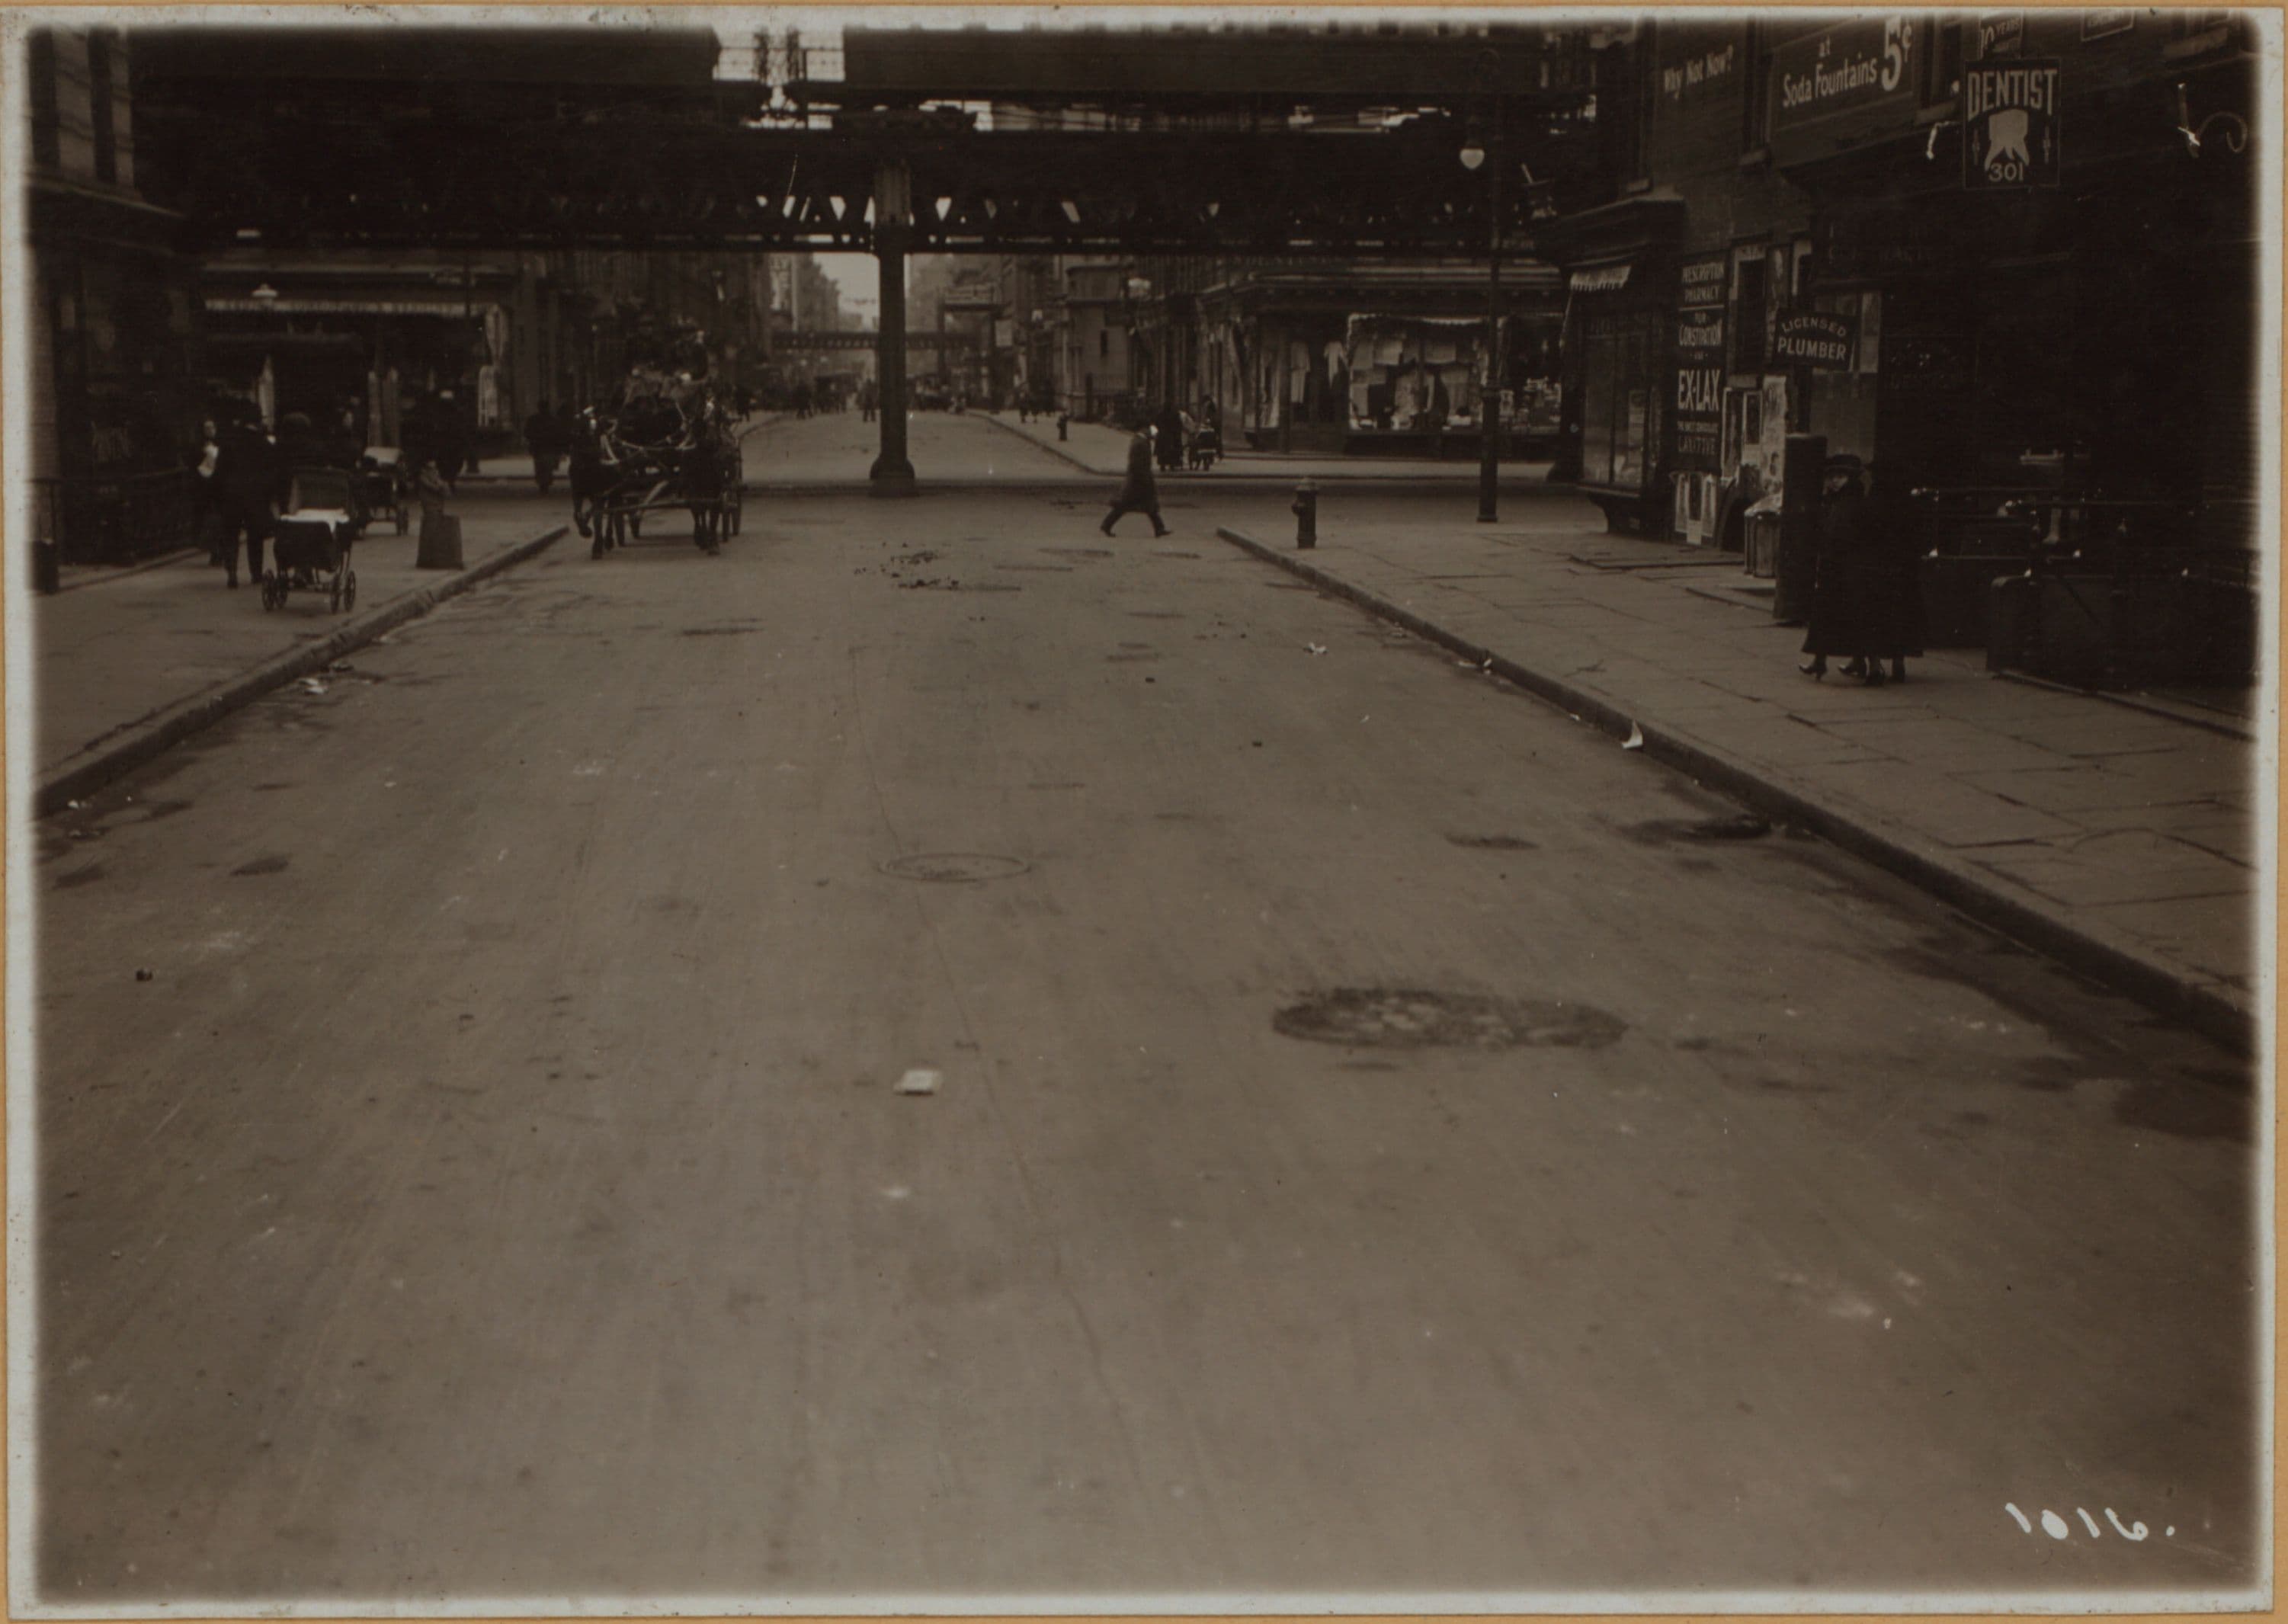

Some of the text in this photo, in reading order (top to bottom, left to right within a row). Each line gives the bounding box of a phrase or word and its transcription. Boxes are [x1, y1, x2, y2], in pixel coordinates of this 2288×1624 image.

[1782, 51, 1878, 109] Soda Fountains
[1967, 68, 2059, 123] DENTIST
[1988, 161, 2024, 182] 301
[1781, 317, 1847, 338] LICENSED
[1777, 335, 1847, 360] PLUMBER
